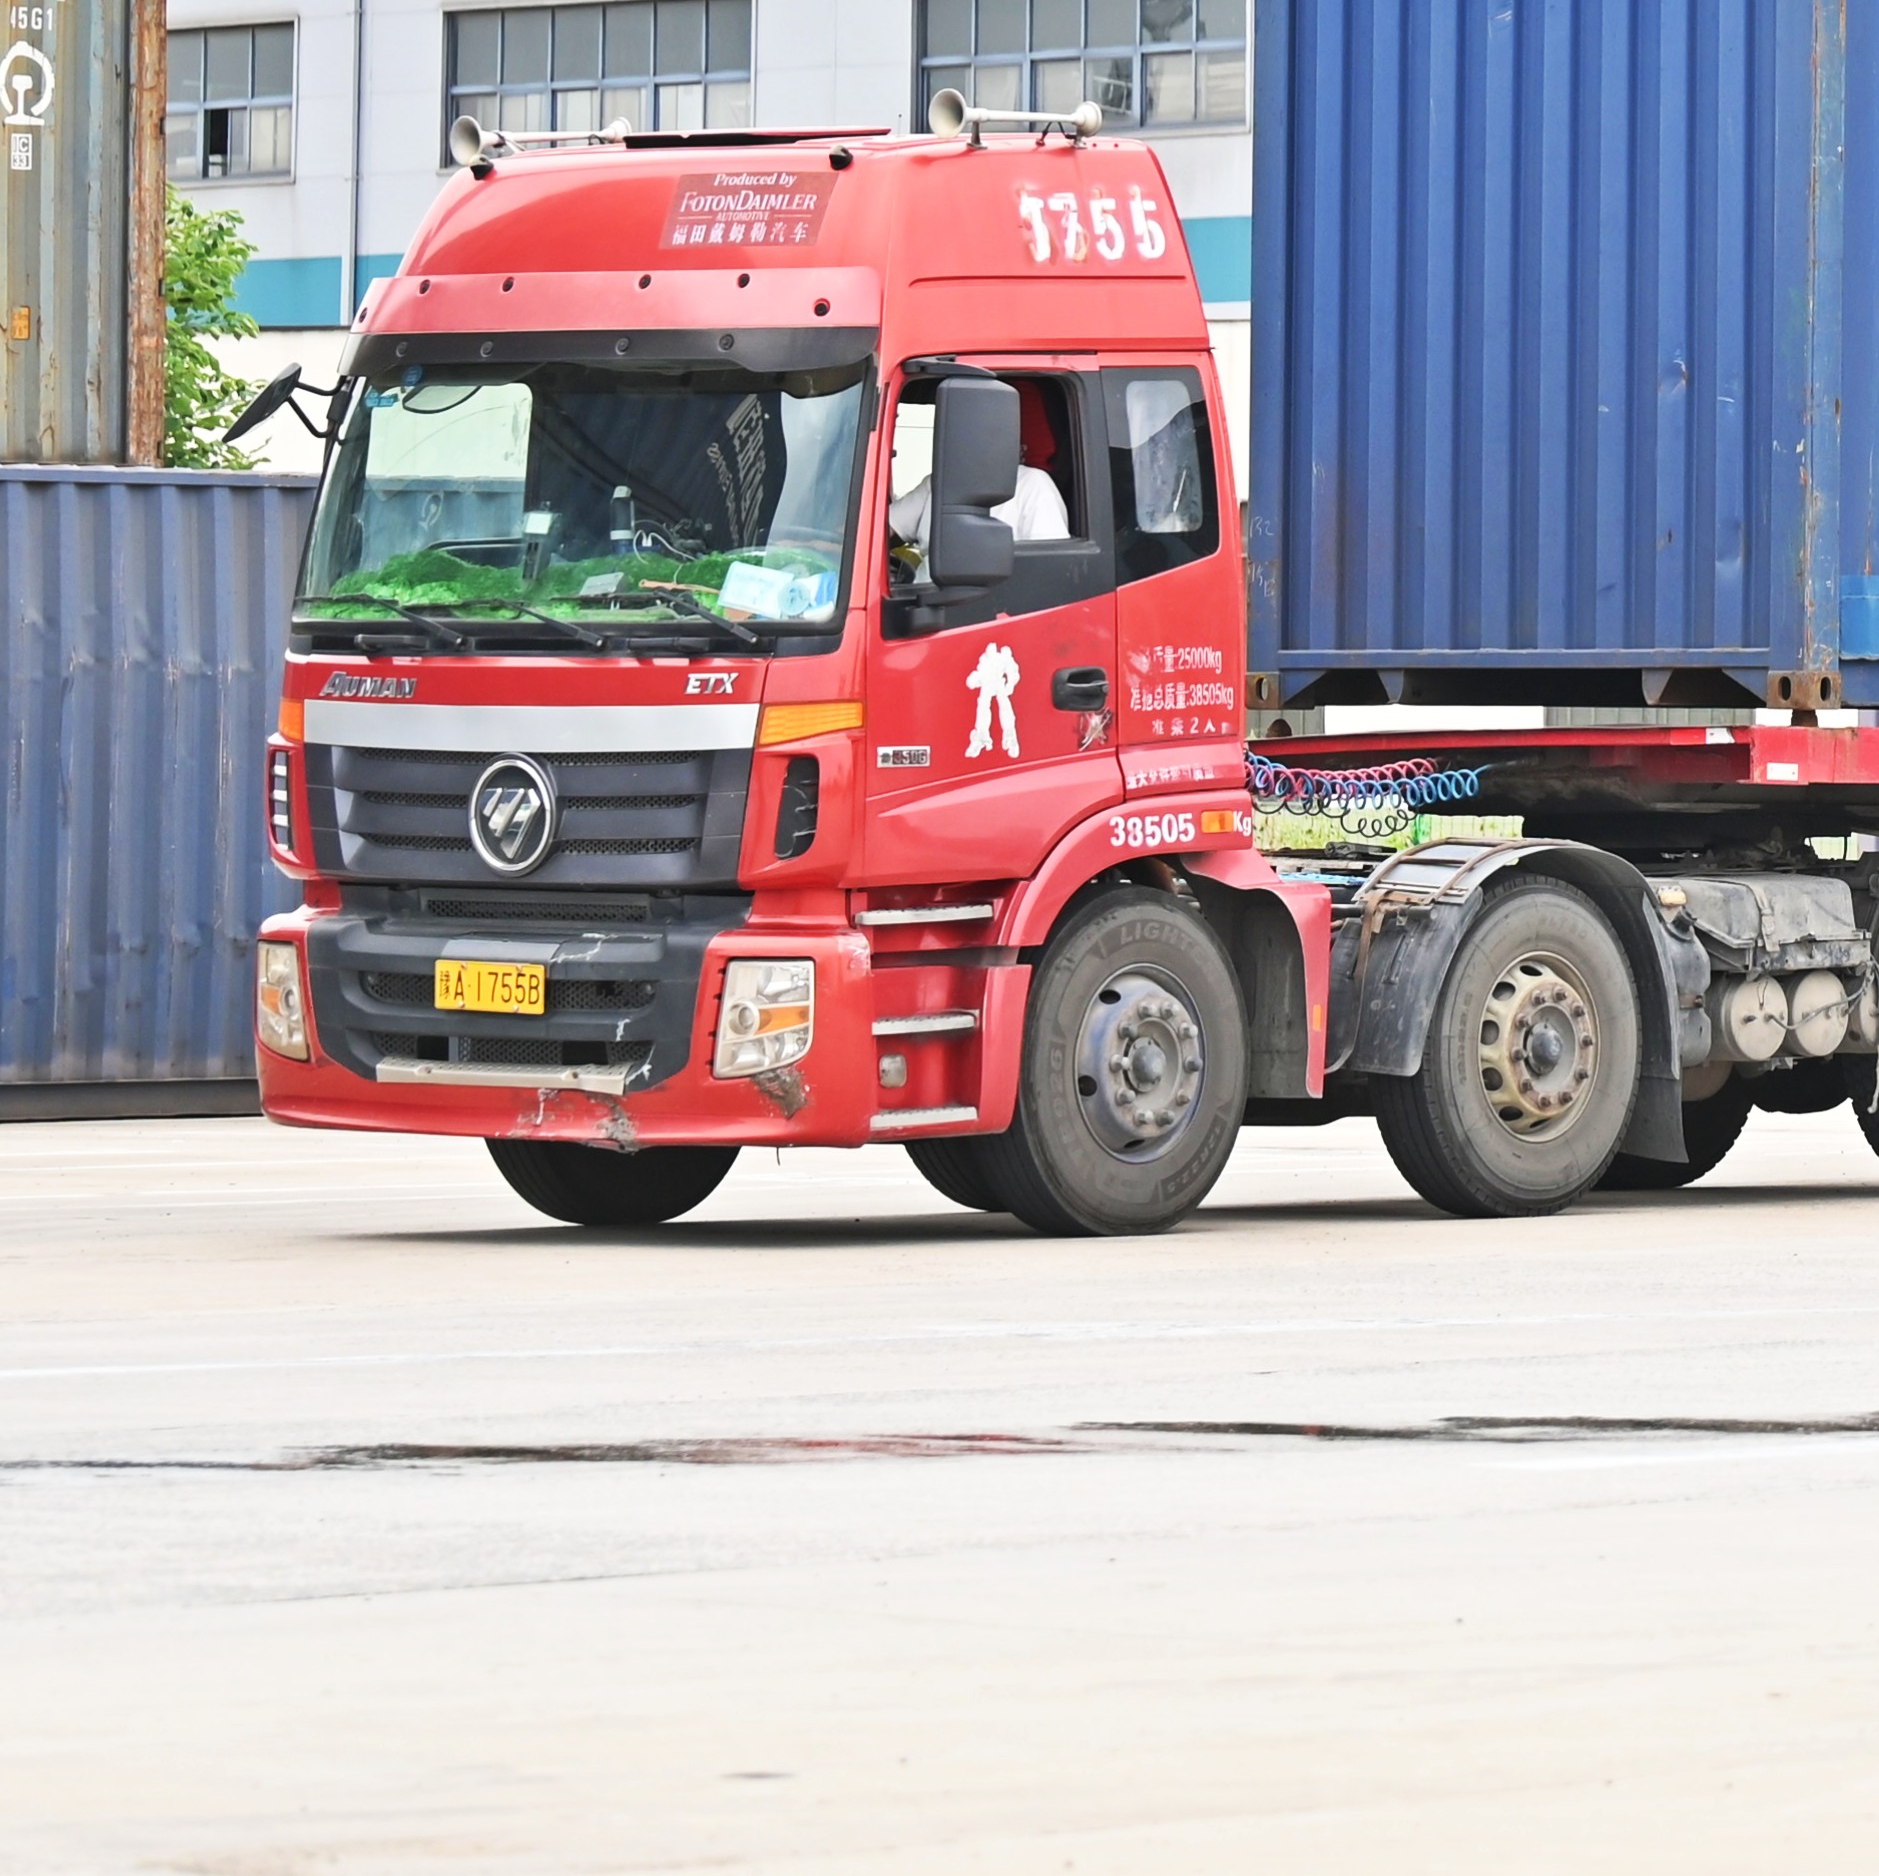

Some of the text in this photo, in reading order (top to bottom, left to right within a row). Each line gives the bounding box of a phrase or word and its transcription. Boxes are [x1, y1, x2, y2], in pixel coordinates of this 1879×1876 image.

[713, 172, 798, 188] Produced by
[671, 221, 809, 246] 福田戴姆勒汽车
[319, 671, 418, 699] AUMAN
[684, 672, 740, 695] ETX
[1110, 810, 1252, 848] 38505 Kg
